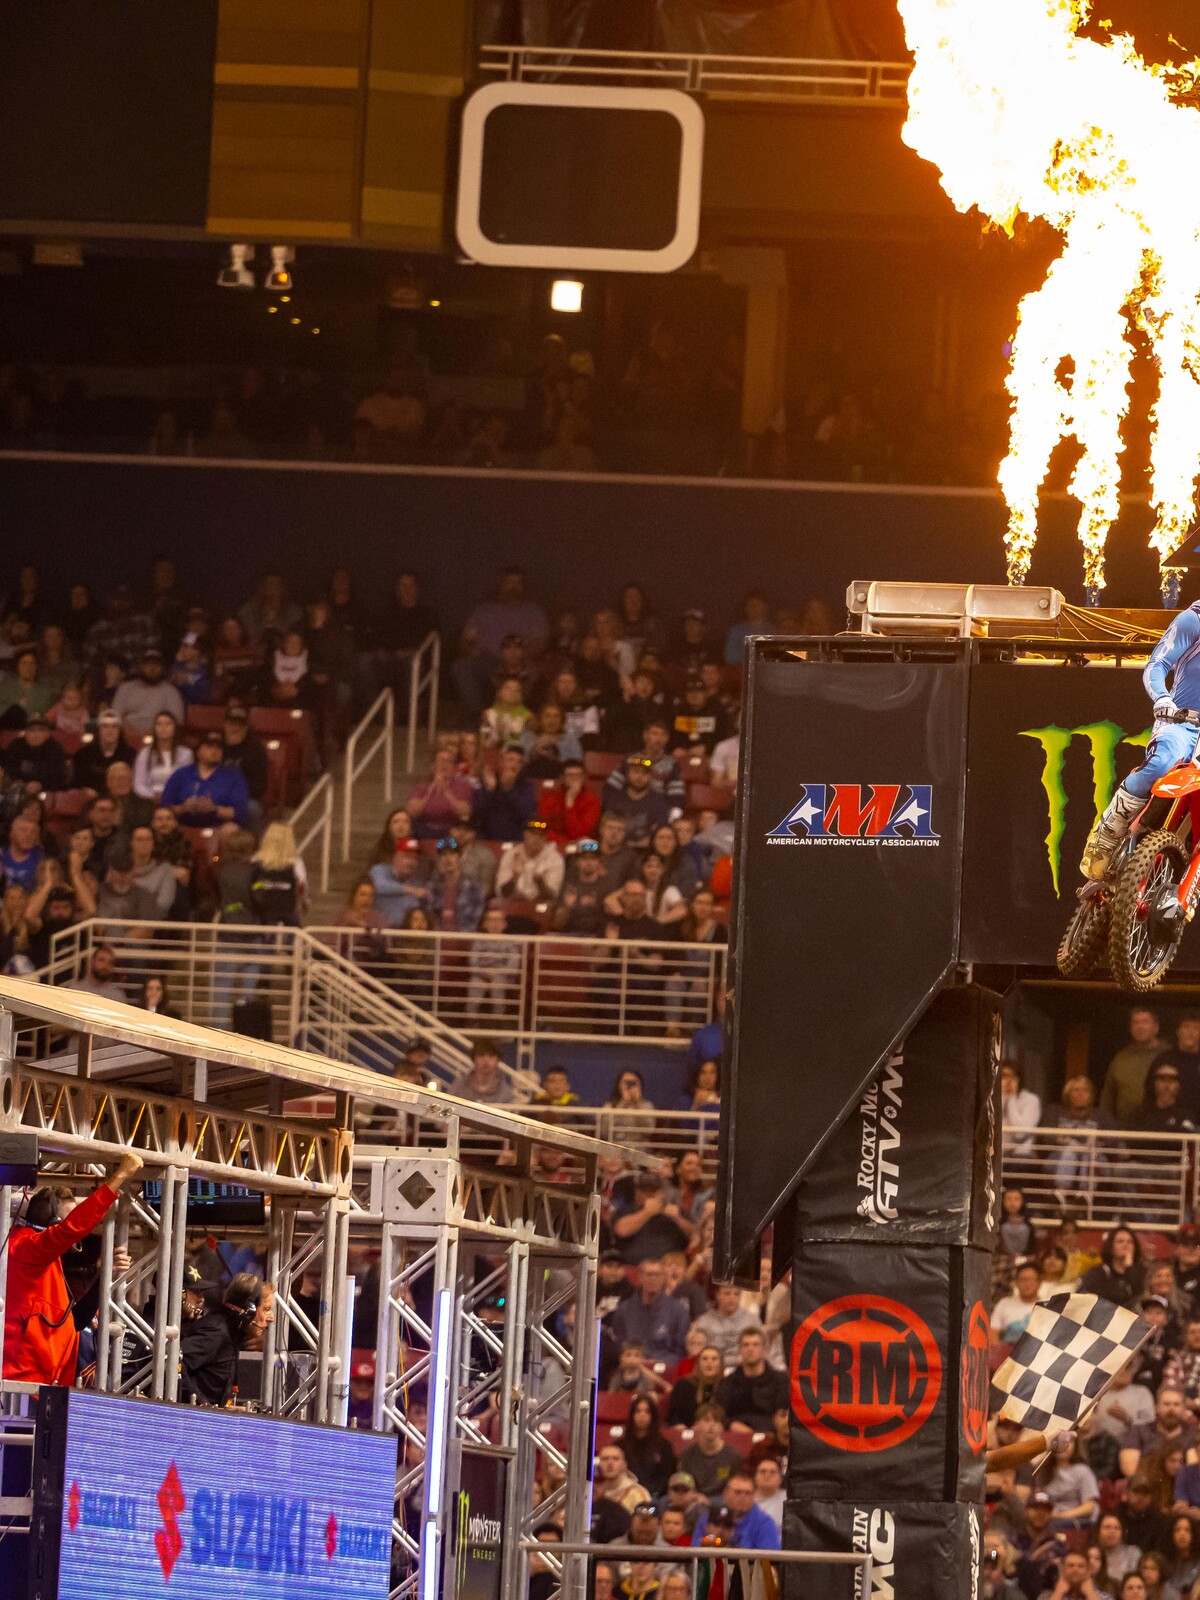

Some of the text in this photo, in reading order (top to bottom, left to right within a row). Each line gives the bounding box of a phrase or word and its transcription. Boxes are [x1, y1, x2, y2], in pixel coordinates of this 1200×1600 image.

[765, 783, 941, 838] AMA
[766, 837, 940, 847] AMERICAN MOTORCYCLIST ASSOCIATION
[857, 1120, 877, 1191] ROCKY
[817, 1340, 910, 1405] RM
[191, 1487, 307, 1575] SUZUKI
[468, 1512, 502, 1544] MONSTER
[472, 1548, 497, 1560] ENERGY
